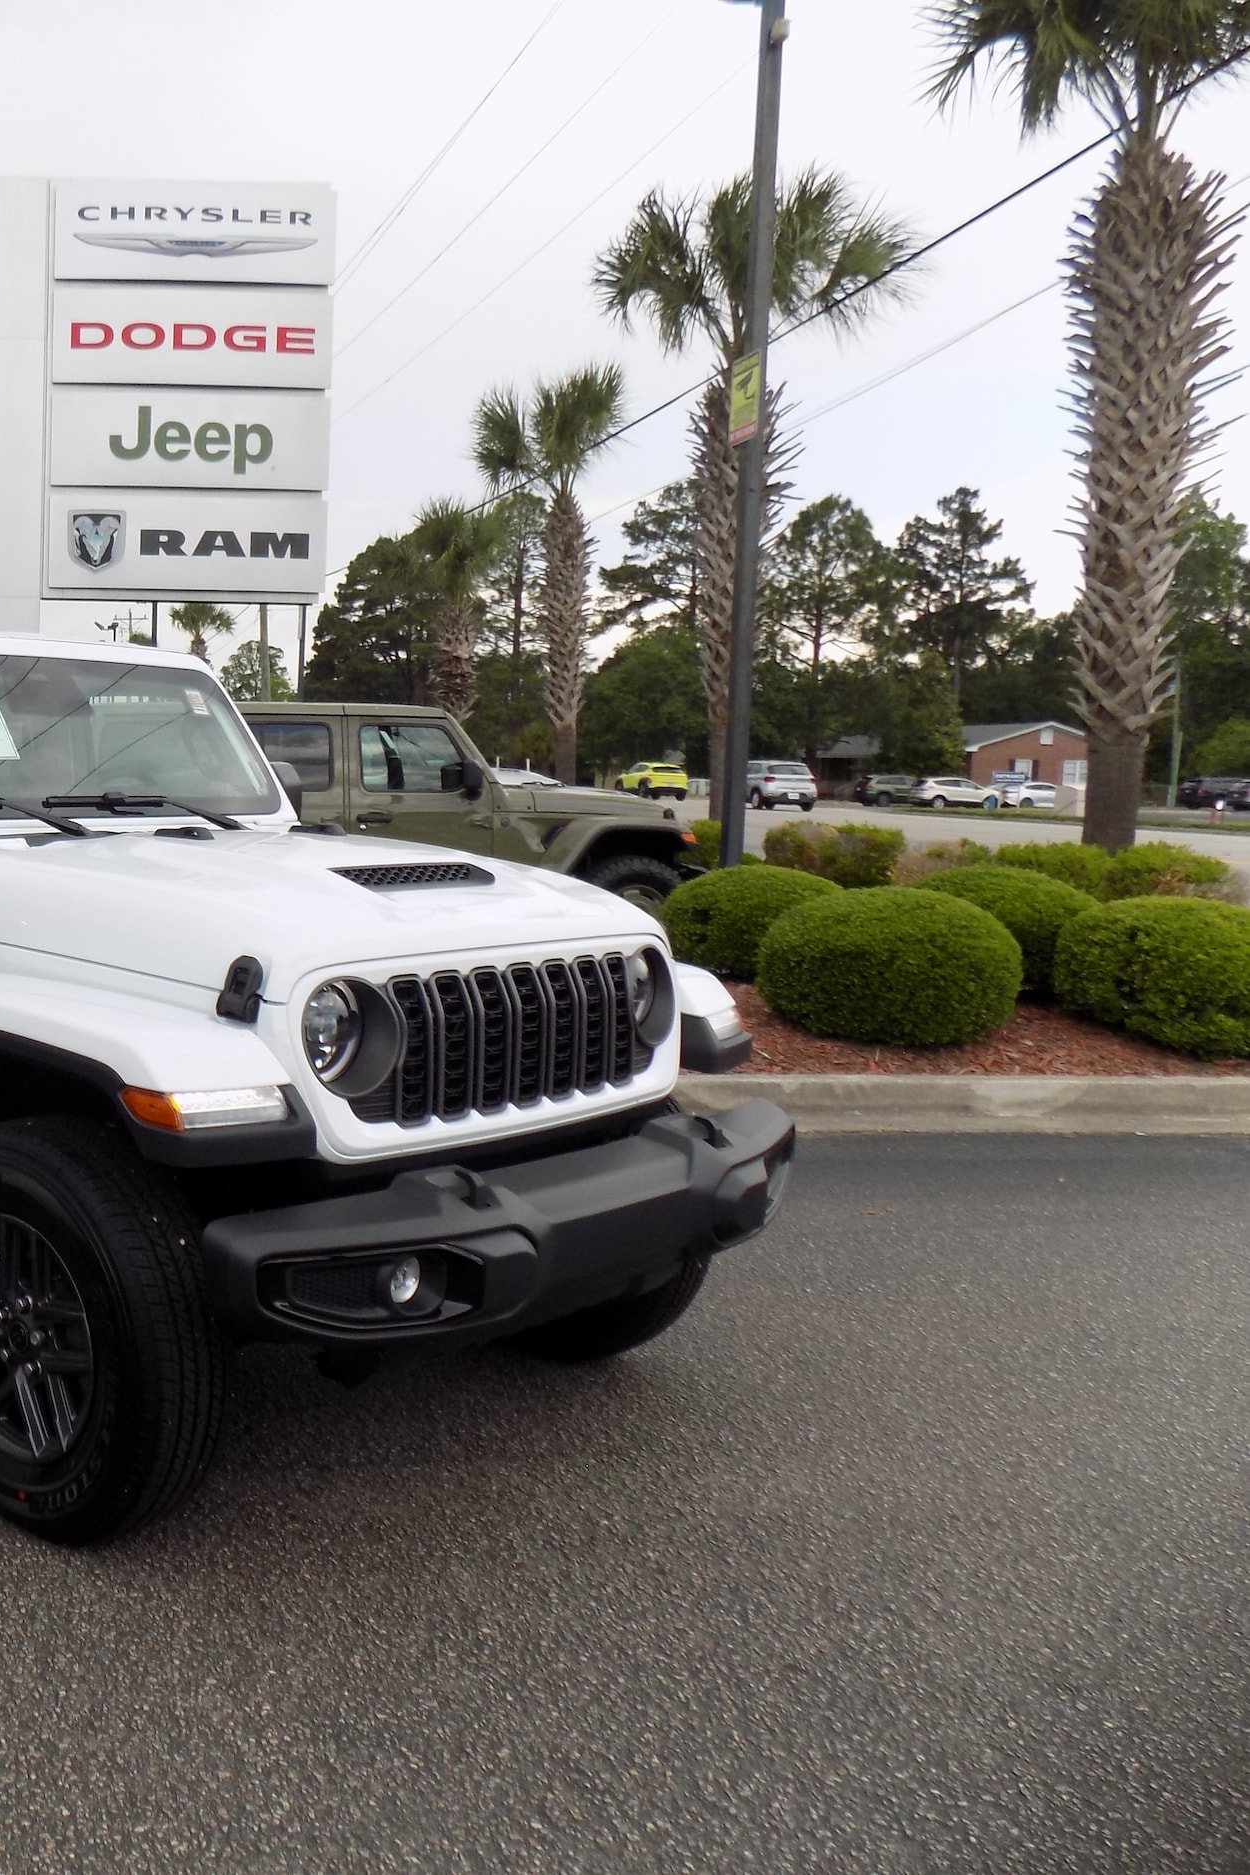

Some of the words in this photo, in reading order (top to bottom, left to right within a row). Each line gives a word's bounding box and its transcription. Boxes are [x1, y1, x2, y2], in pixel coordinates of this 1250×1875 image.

[77, 206, 312, 226] CHRYSLER
[71, 322, 316, 354] DODGE
[109, 405, 273, 475] Jeep
[140, 530, 310, 560] RAM
